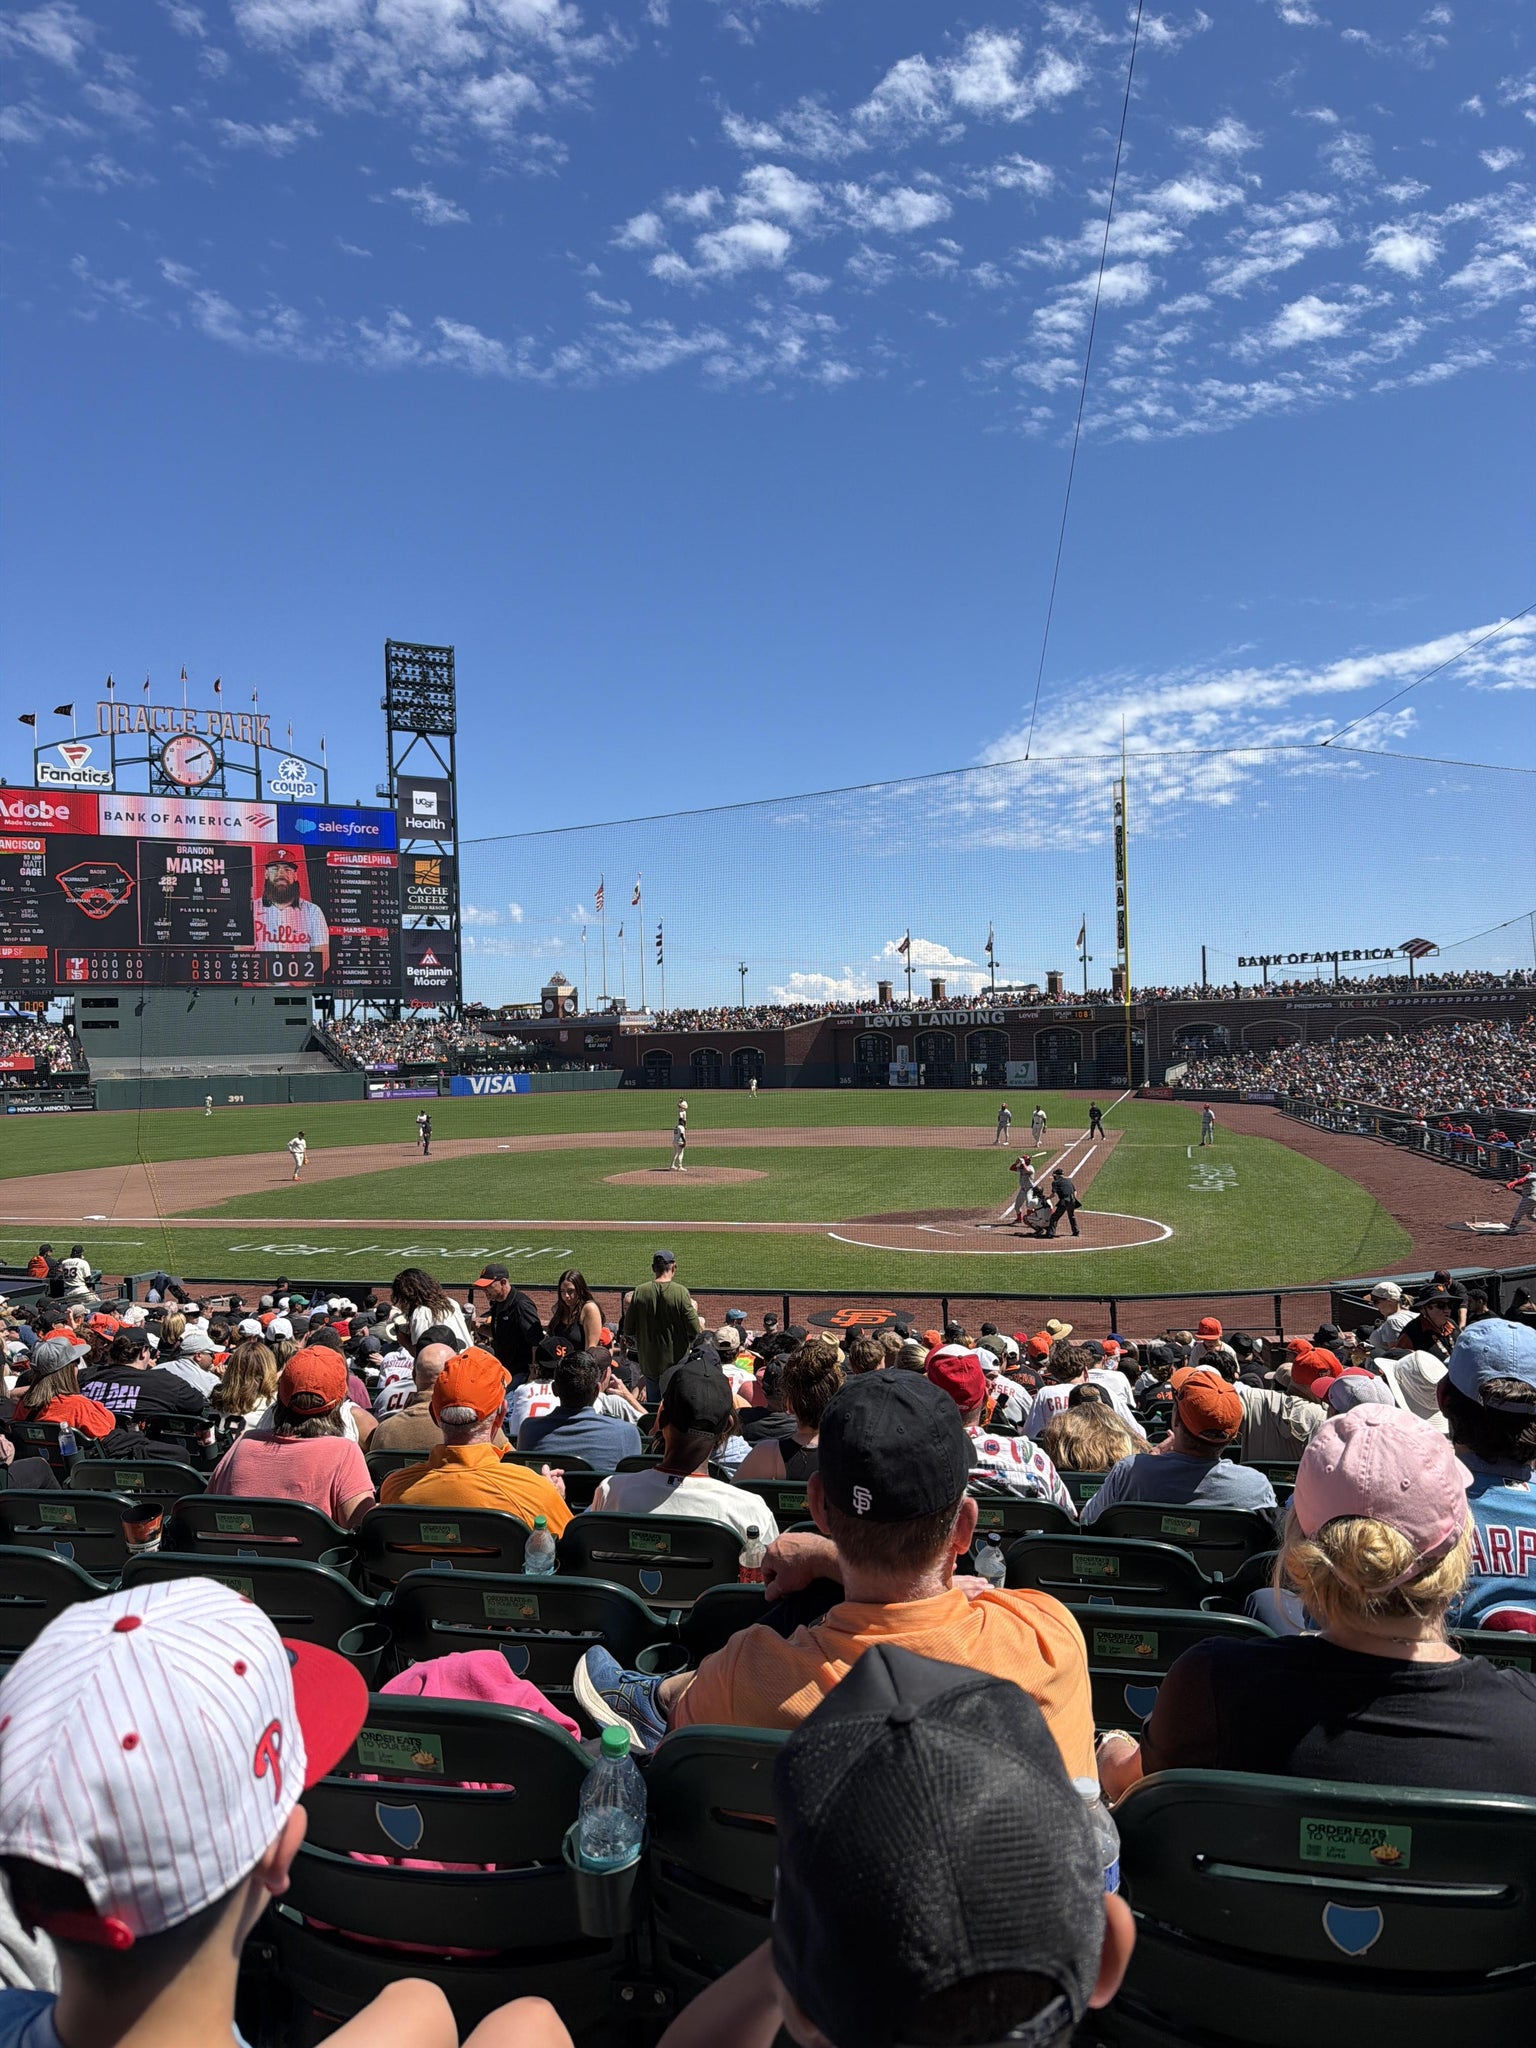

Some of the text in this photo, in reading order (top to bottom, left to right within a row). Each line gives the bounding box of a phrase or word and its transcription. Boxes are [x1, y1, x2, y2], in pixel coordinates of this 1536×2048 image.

[97, 701, 272, 748] ORACLE PARK
[40, 766, 110, 784] Fanatics
[273, 780, 314, 795] coupa
[0, 799, 70, 820] Adobe
[415, 798, 435, 809] UCSF
[104, 811, 242, 827] BANK OF AMERICA
[405, 817, 446, 830] Health
[318, 821, 379, 836] salesforce
[0, 839, 41, 851] ANCISCO
[176, 846, 214, 855] BRANDON
[23, 860, 42, 868] MATT
[166, 857, 225, 875] MARSH
[333, 854, 392, 865] PHILADELPHIA
[20, 867, 42, 876] GAGE
[221, 878, 229, 887] 6
[407, 886, 449, 895] CACHE
[408, 895, 447, 904] CREEK
[254, 920, 312, 943] Phillies
[2, 948, 13, 956] UP
[1238, 948, 1394, 967] BANK OF AMERICA
[92, 959, 259, 970] 0 0 0 0 0 0 3 0 6 4 2
[273, 962, 315, 977] 0 0 2
[92, 970, 260, 980] 0 0 0 0 0 0 3 0 2 3 2
[406, 966, 453, 977] Benjamin
[413, 977, 447, 986] Moore
[24, 1001, 45, 1012] 0:09
[918, 1011, 1005, 1026] LANDING
[466, 1076, 517, 1094] VISA
[228, 1095, 244, 1103] 391
[228, 1243, 574, 1258] UCSF Health
[62, 1267, 78, 1279] 23
[555, 1344, 567, 1357] SF
[853, 1485, 873, 1515] SF
[1096, 1631, 1124, 1640] ORDER
[360, 1731, 423, 1747] ORDER EATS
[377, 1742, 400, 1751] YOUR
[253, 1718, 284, 1806] P
[1306, 1823, 1387, 1838] ORDER EATS
[1308, 1831, 1323, 1840] TO
[1327, 1833, 1356, 1844] YOUR
